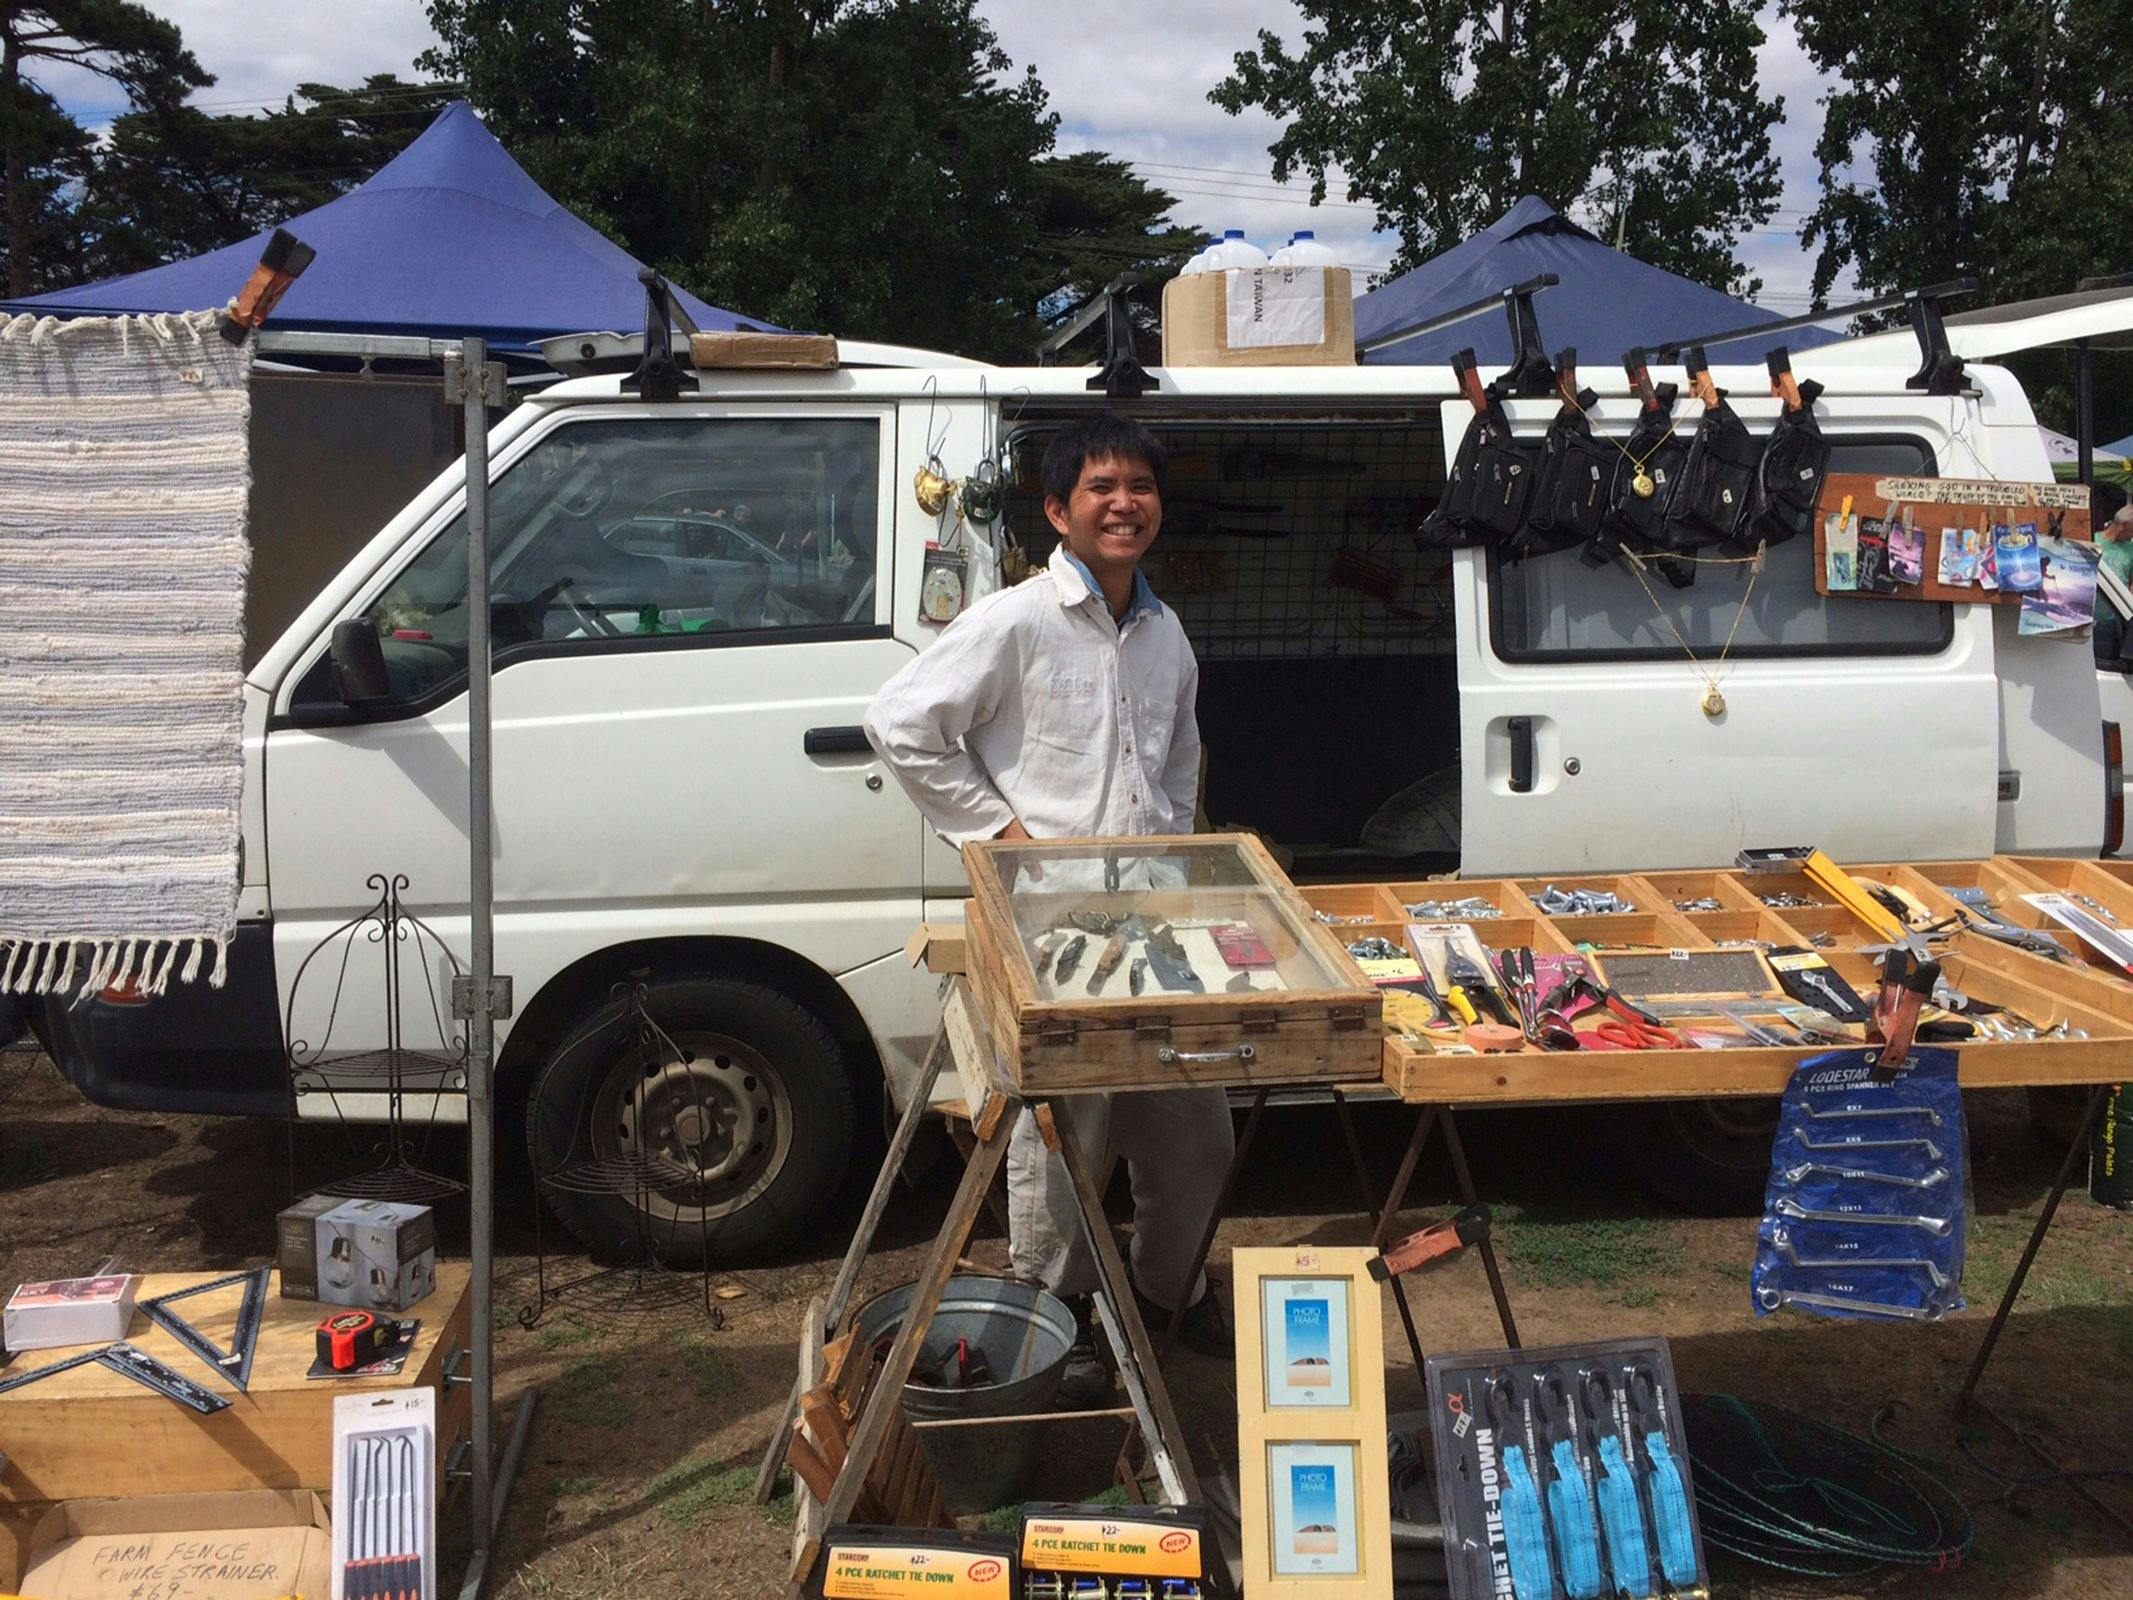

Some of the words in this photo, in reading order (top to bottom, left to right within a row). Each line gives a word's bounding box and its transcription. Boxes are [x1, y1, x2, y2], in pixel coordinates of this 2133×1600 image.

[1253, 278, 1264, 323] TAIWAN
[1887, 480, 1931, 491] SEEKING
[1938, 482, 1958, 491] GOD
[1809, 1067, 1871, 1084] LODESTAR
[1826, 1082, 1845, 1092] RING
[1846, 1080, 1880, 1091] SPANNER
[1293, 1307, 1321, 1316] PHOTO
[1294, 1315, 1321, 1325] FRAME
[1299, 1473, 1328, 1482] PHOTO
[1301, 1482, 1327, 1491] FRAME
[1476, 1428, 1505, 1547] TIE-DOWN
[1033, 1525, 1065, 1535] STARCORP
[1032, 1538, 1040, 1549] 4
[1041, 1539, 1058, 1550] PCE
[1061, 1540, 1100, 1552] RATCHET
[1103, 1542, 1118, 1553] TIE
[1119, 1543, 1147, 1555] DOWN
[1165, 1537, 1187, 1549] NEW
[93, 1544, 152, 1565] FARM
[166, 1542, 251, 1562] FENCE
[118, 1564, 169, 1584] WIRE
[835, 1566, 843, 1577] 4
[845, 1567, 863, 1579] PCE
[865, 1568, 907, 1581] RATCHET
[908, 1571, 924, 1582] TIE
[925, 1572, 955, 1584] DOWN
[974, 1566, 995, 1577] NEW
